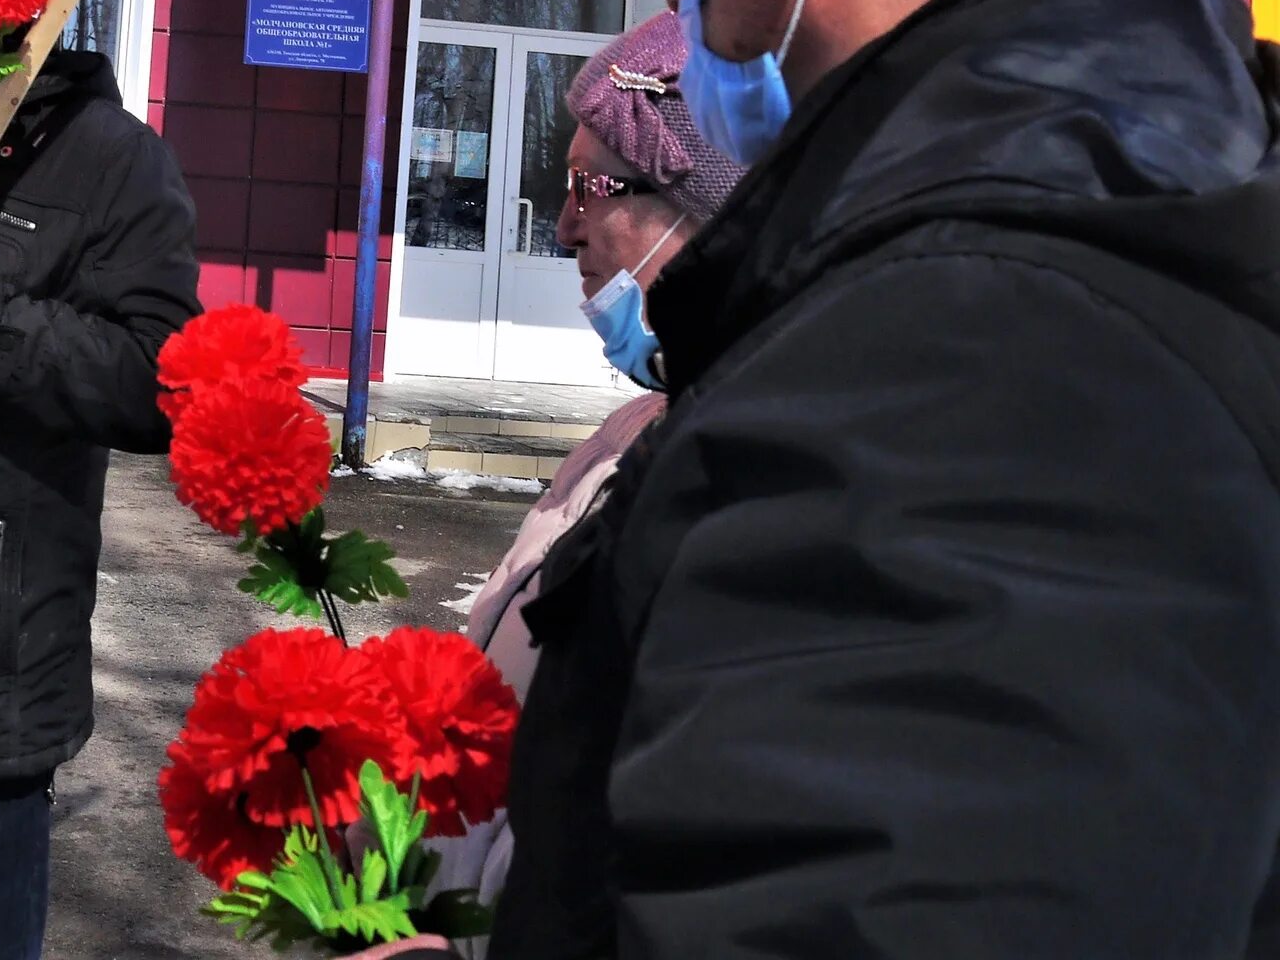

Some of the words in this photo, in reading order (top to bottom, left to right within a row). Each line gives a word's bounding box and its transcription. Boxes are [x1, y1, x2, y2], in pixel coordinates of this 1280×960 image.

[252, 19, 326, 31] «МОЛЧАНОВСКАЯ
[326, 24, 365, 34] СРЕДНЯЯ
[256, 28, 360, 42] ОБЩЕОБРАЗОВАТЕЛЬНАЯ
[283, 38, 315, 48] ШКОЛА
